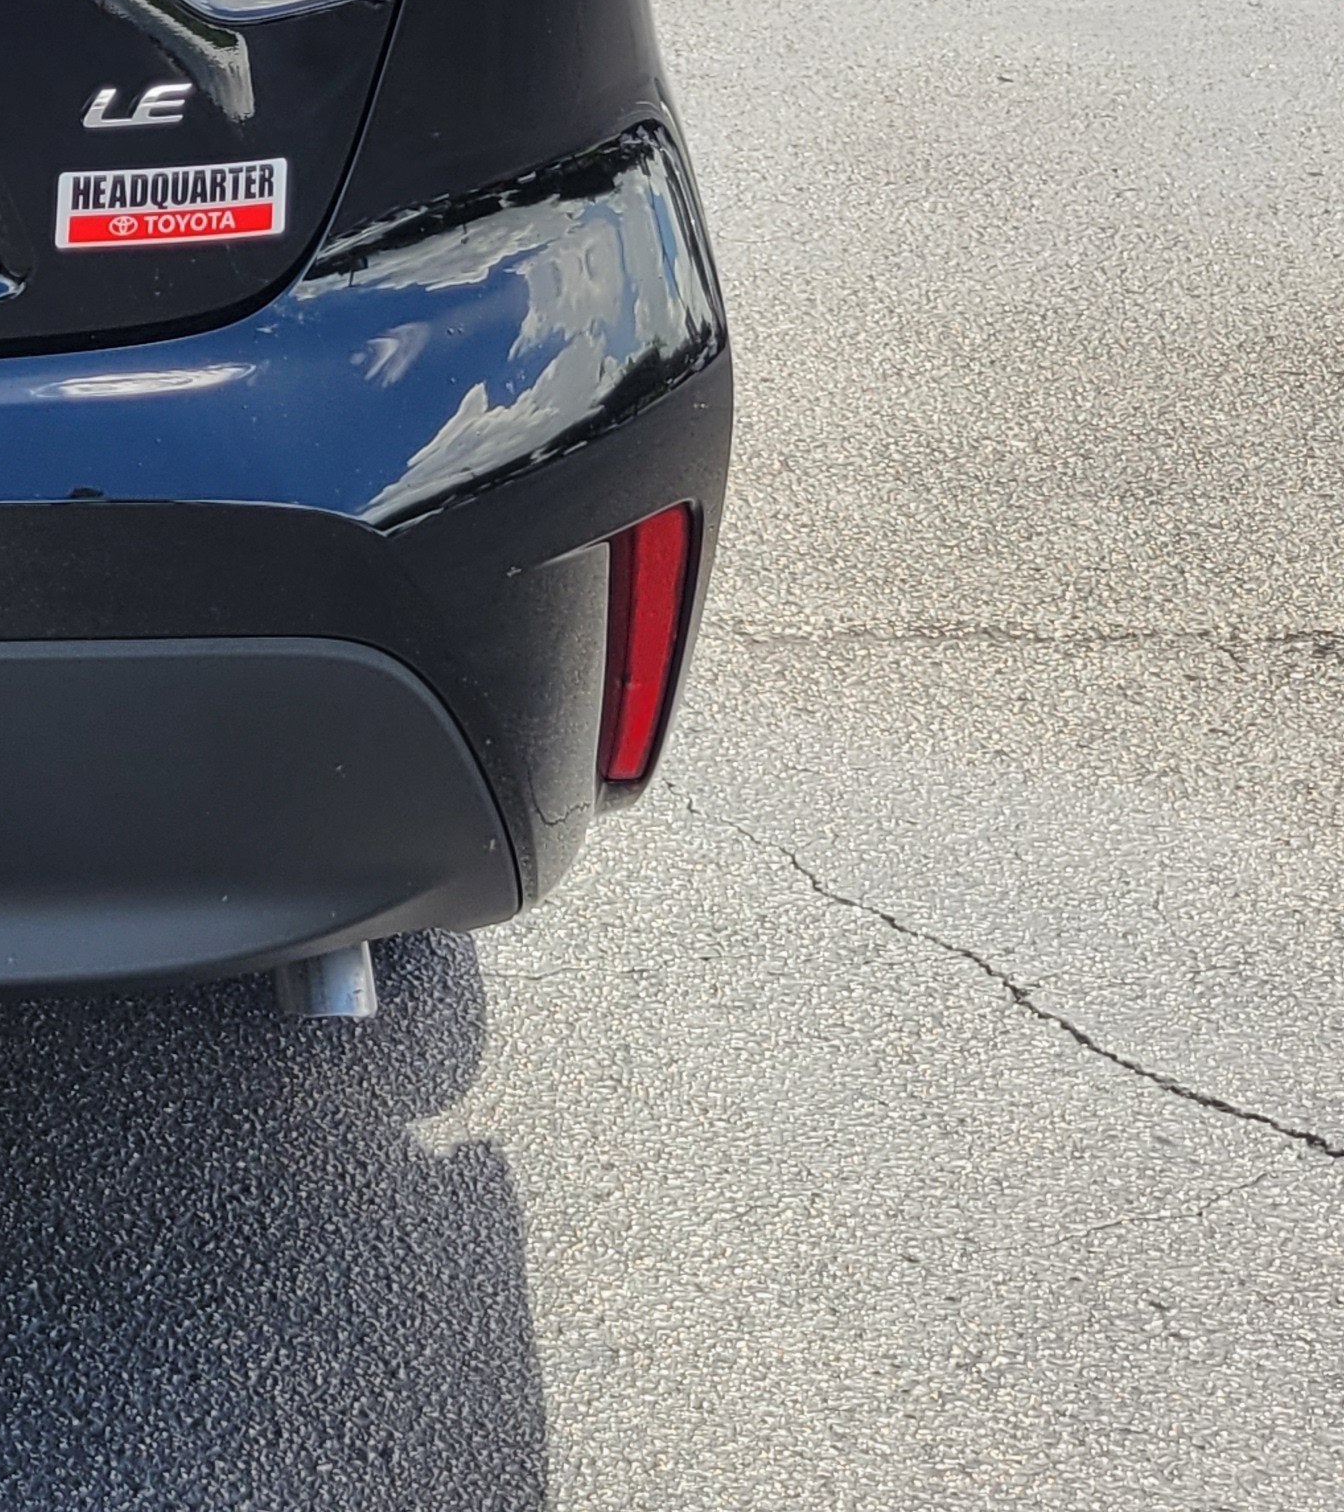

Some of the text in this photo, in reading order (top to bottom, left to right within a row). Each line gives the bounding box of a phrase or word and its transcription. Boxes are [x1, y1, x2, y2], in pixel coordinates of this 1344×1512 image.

[82, 82, 193, 129] LE
[70, 163, 275, 211] HEADQUARTER
[143, 211, 236, 236] TOYOTA
